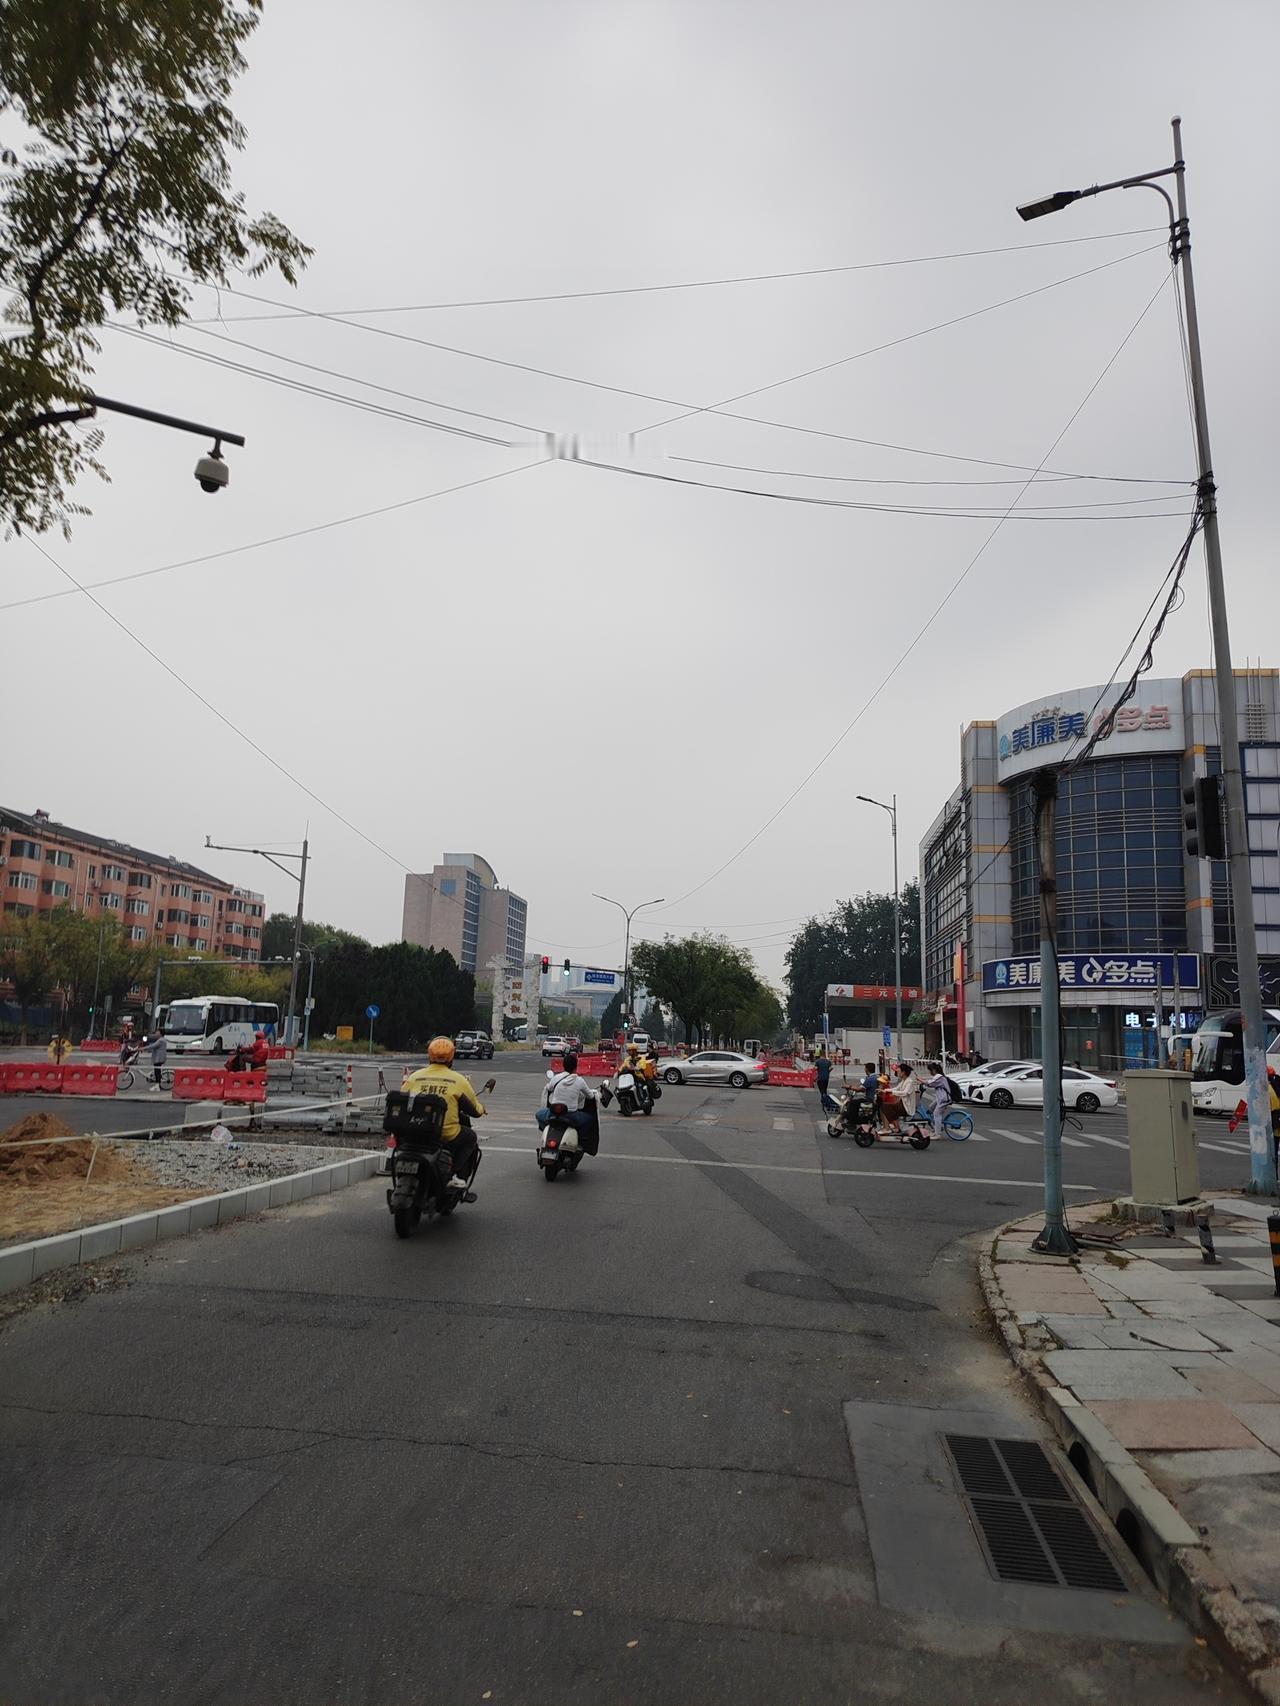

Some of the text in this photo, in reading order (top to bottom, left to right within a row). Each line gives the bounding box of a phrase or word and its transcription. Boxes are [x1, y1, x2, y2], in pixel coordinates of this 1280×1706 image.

[1012, 712, 1085, 753] 美廉美
[1117, 706, 1170, 732] 多点
[1009, 960, 1155, 985] 美廉美 多点
